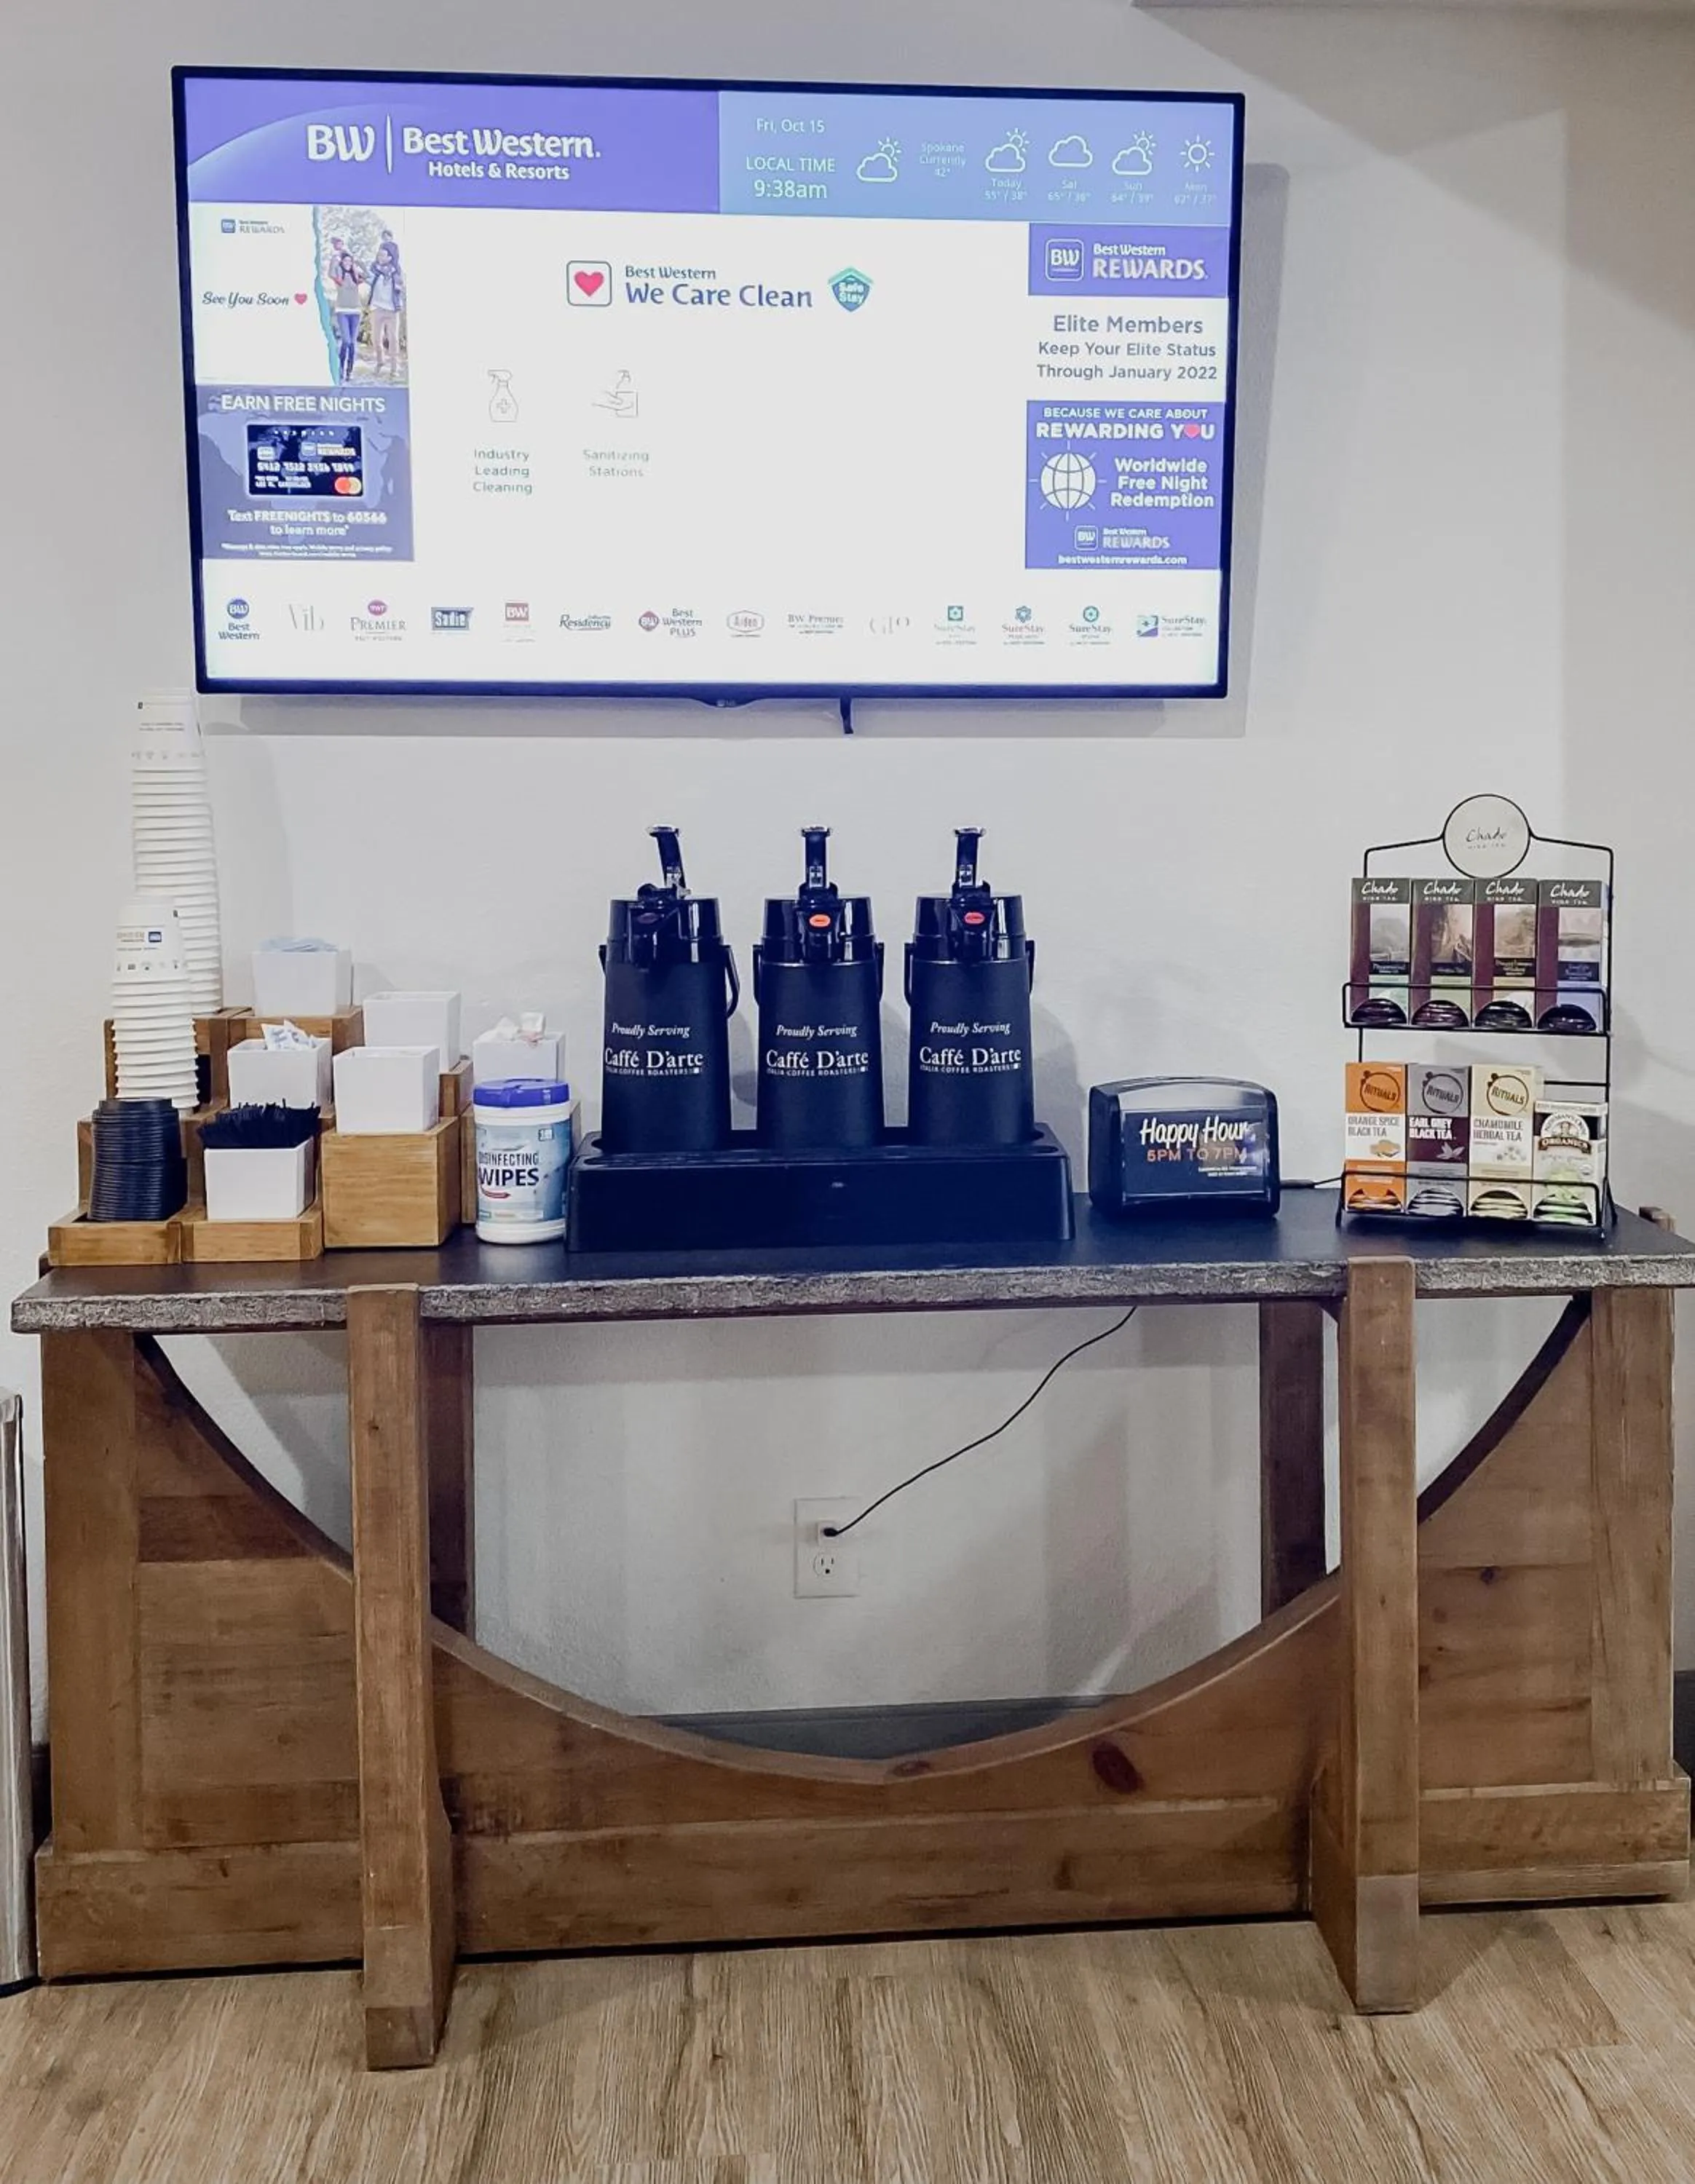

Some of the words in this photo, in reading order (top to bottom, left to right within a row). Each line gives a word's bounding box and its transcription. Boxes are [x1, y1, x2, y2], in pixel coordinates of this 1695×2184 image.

[756, 118, 777, 134] Fri,
[781, 119, 805, 133] Oct
[810, 120, 825, 134] 15
[307, 124, 375, 162] BW
[403, 127, 468, 155] Best
[921, 142, 965, 155] Spokane
[428, 162, 483, 178] Hotels
[488, 162, 502, 178] &
[505, 162, 570, 180] Resorts
[746, 157, 794, 172] LOCAL
[799, 158, 836, 173] TIME
[754, 180, 828, 199] 9:38am
[992, 178, 1022, 190] Today
[1050, 248, 1080, 266] BW
[1093, 243, 1118, 255] Best
[1119, 244, 1166, 256] Western
[625, 265, 655, 278] Best
[658, 266, 716, 280] Western
[202, 291, 226, 305] See
[228, 291, 253, 309] You
[256, 292, 289, 306] Soon
[625, 282, 664, 305] We
[672, 283, 732, 306] Care
[739, 285, 813, 308] Clean
[1054, 315, 1099, 333] Elite
[1107, 316, 1204, 333] Members
[1039, 341, 1079, 357] Keep
[1085, 342, 1121, 356] Your
[1126, 343, 1161, 357] Elite
[1167, 343, 1216, 357] Status
[1037, 364, 1103, 381] Through
[1109, 365, 1171, 381] January
[1177, 366, 1217, 380] 2022
[221, 395, 269, 410] EARN
[274, 396, 316, 411] FREE
[320, 397, 386, 413] NIGHTS
[1044, 407, 1101, 418] BECAUSE
[1105, 408, 1125, 418] WE
[1129, 408, 1161, 419] CARE
[1166, 408, 1208, 419] ABOUT
[1036, 422, 1164, 440] REWARDING
[474, 448, 530, 462] Industry
[582, 448, 649, 462] Sanitizing
[475, 465, 530, 478] Leading
[589, 466, 644, 478] Stations
[1115, 458, 1207, 473] Worldwide
[473, 481, 532, 495] Cleaning
[1118, 476, 1155, 490] Free
[1161, 476, 1208, 492] Night
[1110, 493, 1214, 510] Redemption
[228, 510, 253, 522] Text
[255, 510, 330, 523] FREENIGHTS
[333, 512, 344, 523] to
[270, 525, 282, 535] to
[285, 524, 314, 535] learn
[1078, 531, 1095, 542] BW
[1058, 554, 1188, 566] bestwesternrewards.com
[435, 610, 467, 628] Sadie
[672, 608, 694, 617] Best
[228, 622, 250, 631] Best
[350, 617, 407, 631] PREMIER
[558, 614, 612, 630] Residency
[663, 618, 703, 628] Western
[218, 631, 260, 640] Western
[670, 627, 696, 637] PLUS
[612, 1022, 645, 1039] Proudly
[647, 1025, 690, 1039] Serving
[776, 1024, 815, 1040] Proudly
[818, 1024, 858, 1037] Serving
[931, 1021, 969, 1037] Proudly
[973, 1021, 1011, 1034] Serving
[605, 1048, 640, 1067] Caffé
[767, 1049, 809, 1069] Caffé
[920, 1046, 964, 1066] Caffé
[786, 1069, 815, 1077] COFFEE
[818, 1067, 856, 1076] ROASTERS
[941, 1066, 970, 1074] COFFEE
[973, 1065, 1010, 1073] ROASTERS
[1364, 1083, 1396, 1101] RITUALS
[1426, 1085, 1460, 1103] RITUALS
[1491, 1085, 1525, 1104] RITUALS
[1348, 1117, 1378, 1126] ORANGE
[1379, 1117, 1399, 1126] SPICE
[1410, 1117, 1429, 1127] EARL
[1473, 1118, 1523, 1130] CHAMOMILE
[1139, 1117, 1198, 1149] Happy
[1202, 1115, 1249, 1143] Hour
[1348, 1127, 1371, 1136] BLACK
[1373, 1127, 1387, 1136] TEA
[1410, 1128, 1436, 1139] BLACK
[1437, 1129, 1453, 1140] TEA
[1473, 1129, 1504, 1141] HERBAL
[1506, 1130, 1522, 1142] TEA
[1187, 1148, 1209, 1162] TO
[1214, 1147, 1247, 1163] 7PM
[478, 1168, 540, 1187] WIPES
